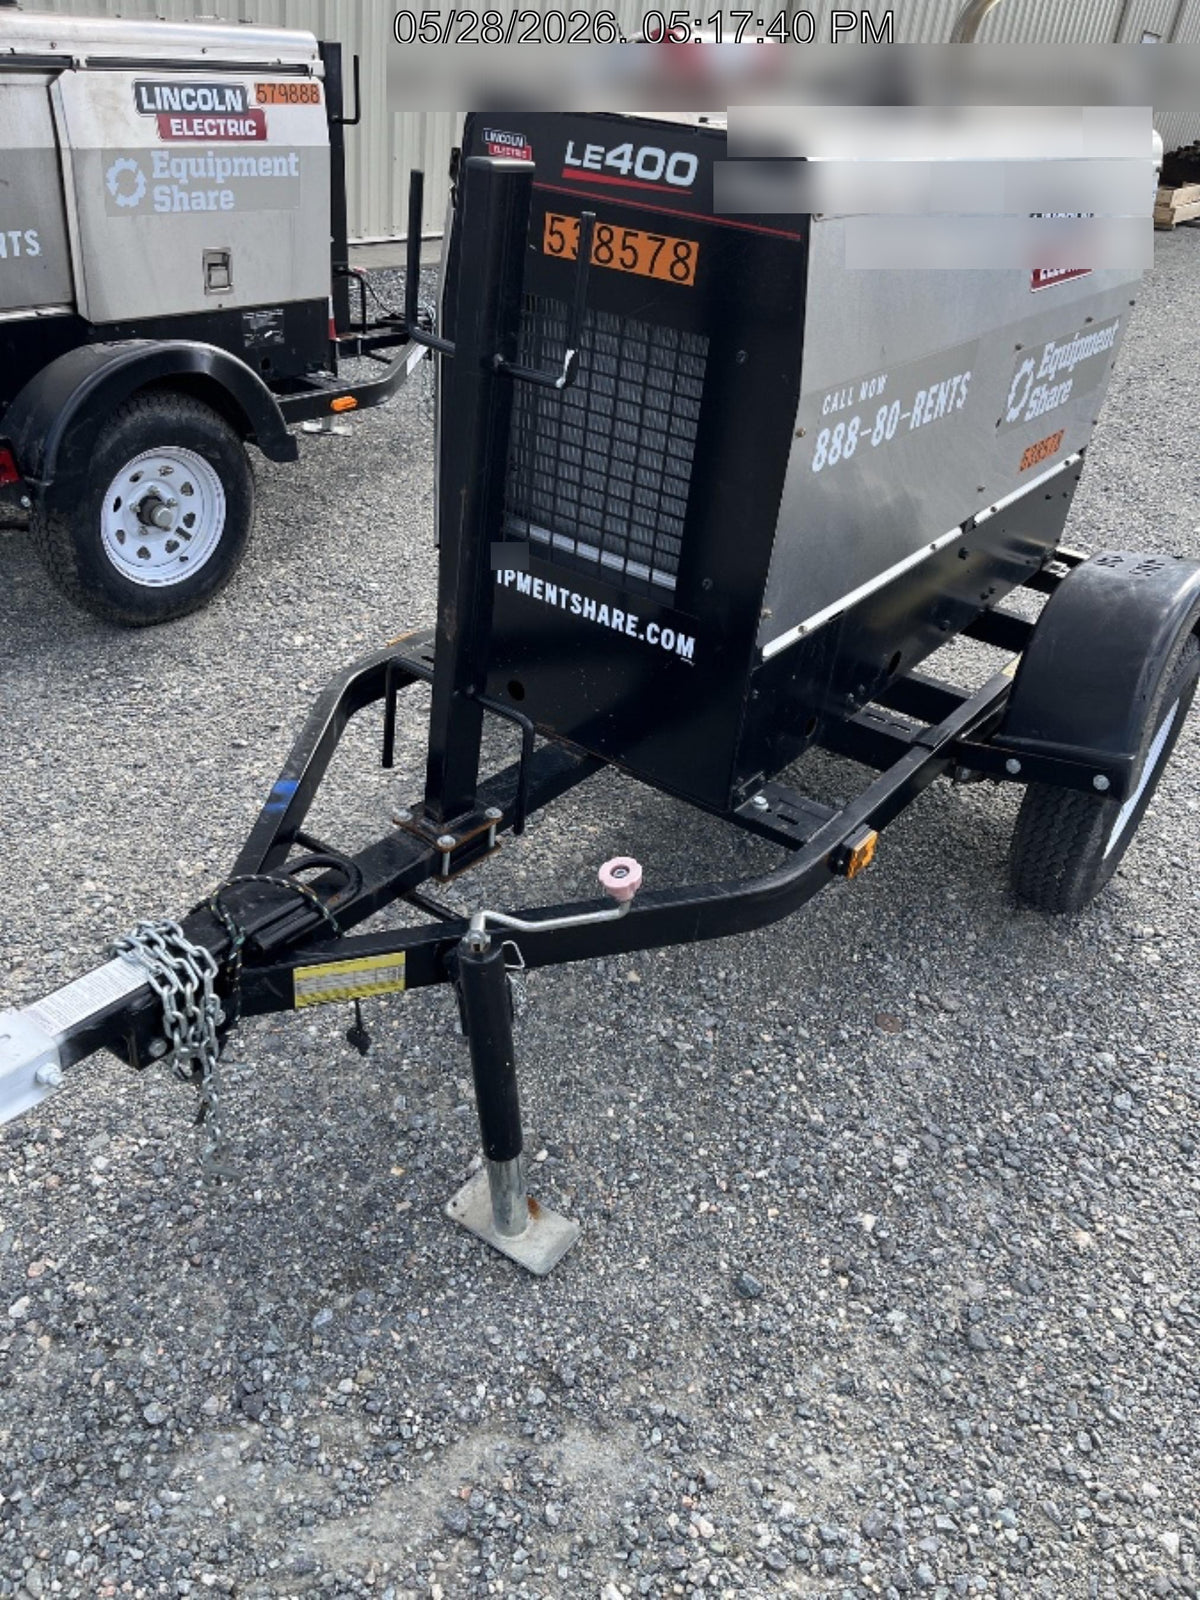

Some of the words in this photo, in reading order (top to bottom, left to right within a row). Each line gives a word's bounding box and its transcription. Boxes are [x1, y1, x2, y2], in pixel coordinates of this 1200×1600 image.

[140, 86, 243, 112] LINCOLN
[256, 83, 320, 104] 579888
[170, 119, 257, 136] ELECTRIC
[151, 151, 299, 184] Equipment
[564, 140, 699, 187] LE400
[153, 185, 235, 213] Share
[1036, 319, 1119, 381] Equipment
[822, 386, 854, 416] CALL
[859, 373, 889, 402] NOW
[1024, 378, 1073, 422] Share
[811, 370, 972, 473] 888-80-RENTS
